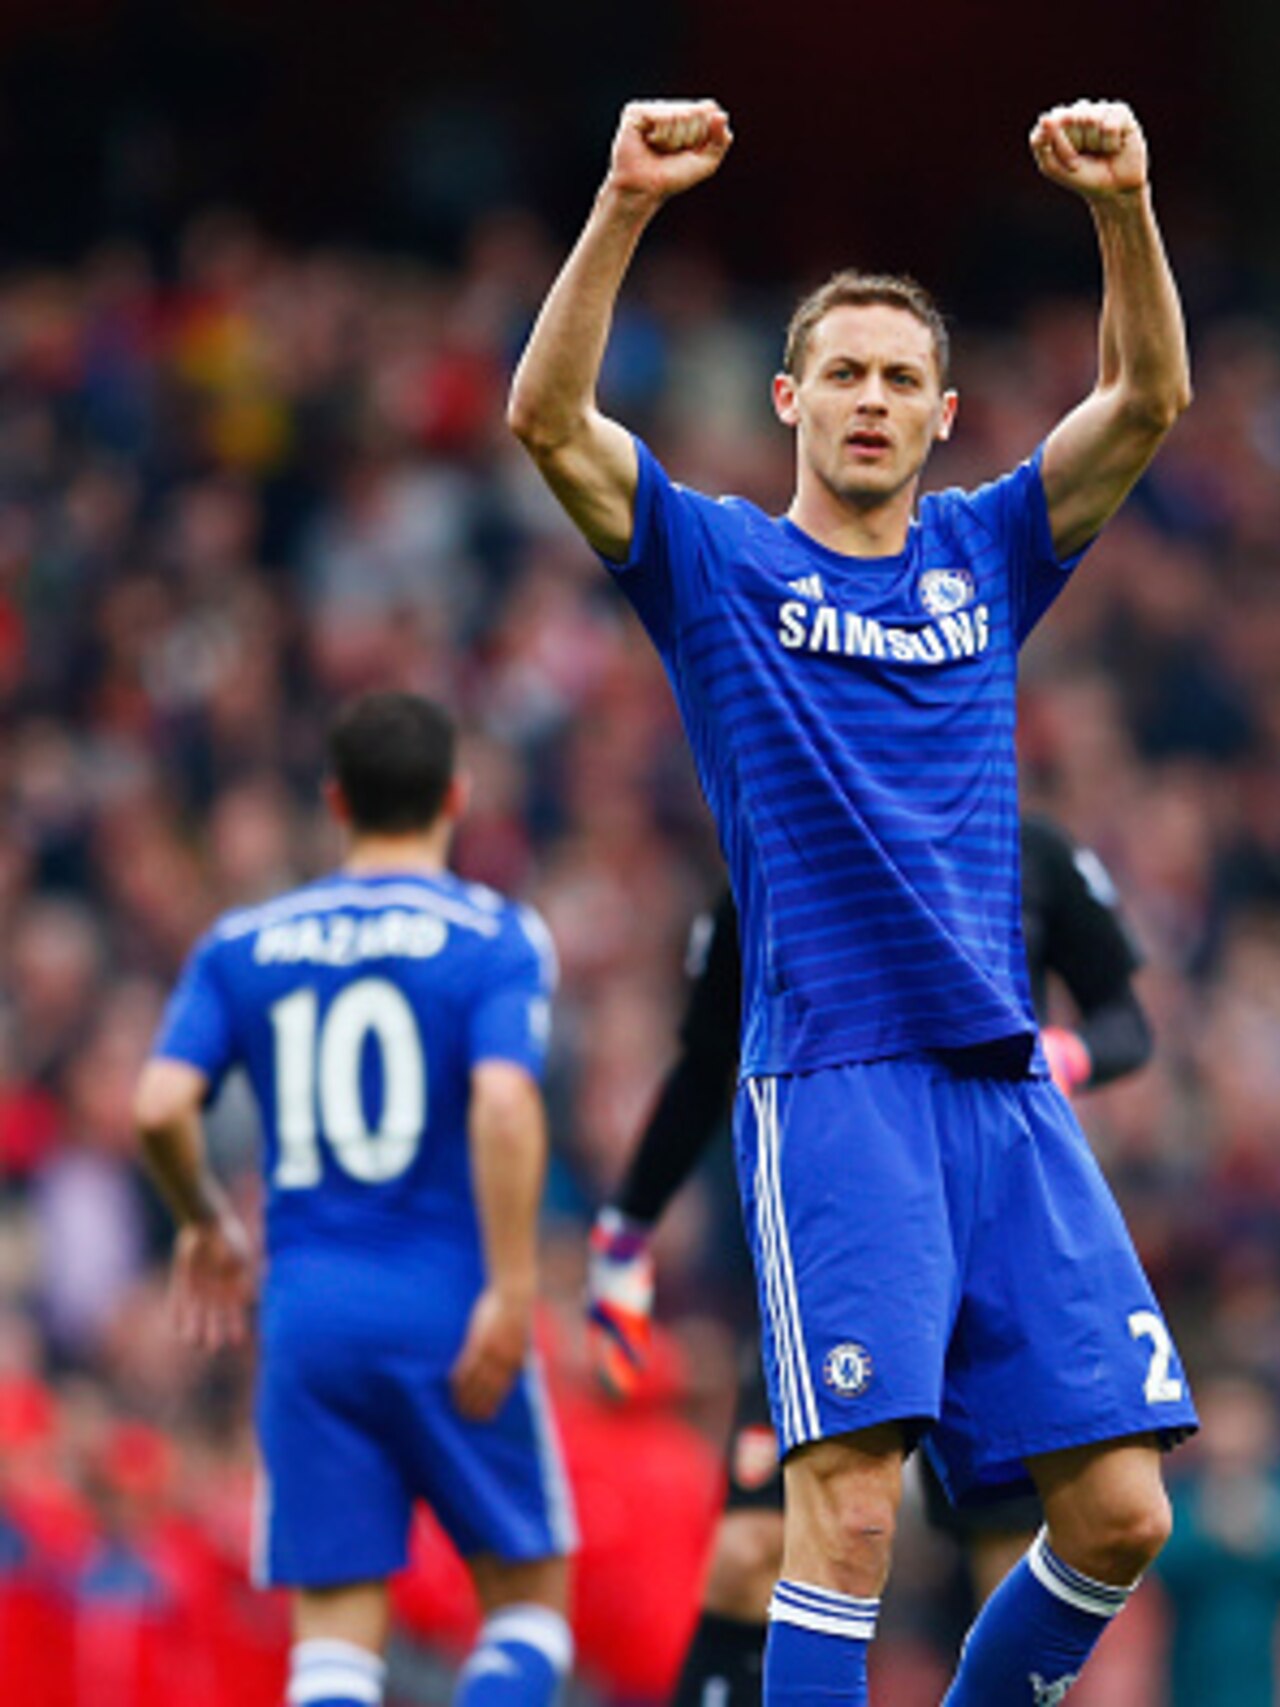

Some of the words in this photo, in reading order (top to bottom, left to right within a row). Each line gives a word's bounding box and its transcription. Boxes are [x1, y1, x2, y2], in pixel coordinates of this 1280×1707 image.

[778, 600, 988, 665] SAMSUNG
[271, 974, 427, 1189] 10
[1127, 1309, 1182, 1405] 2
